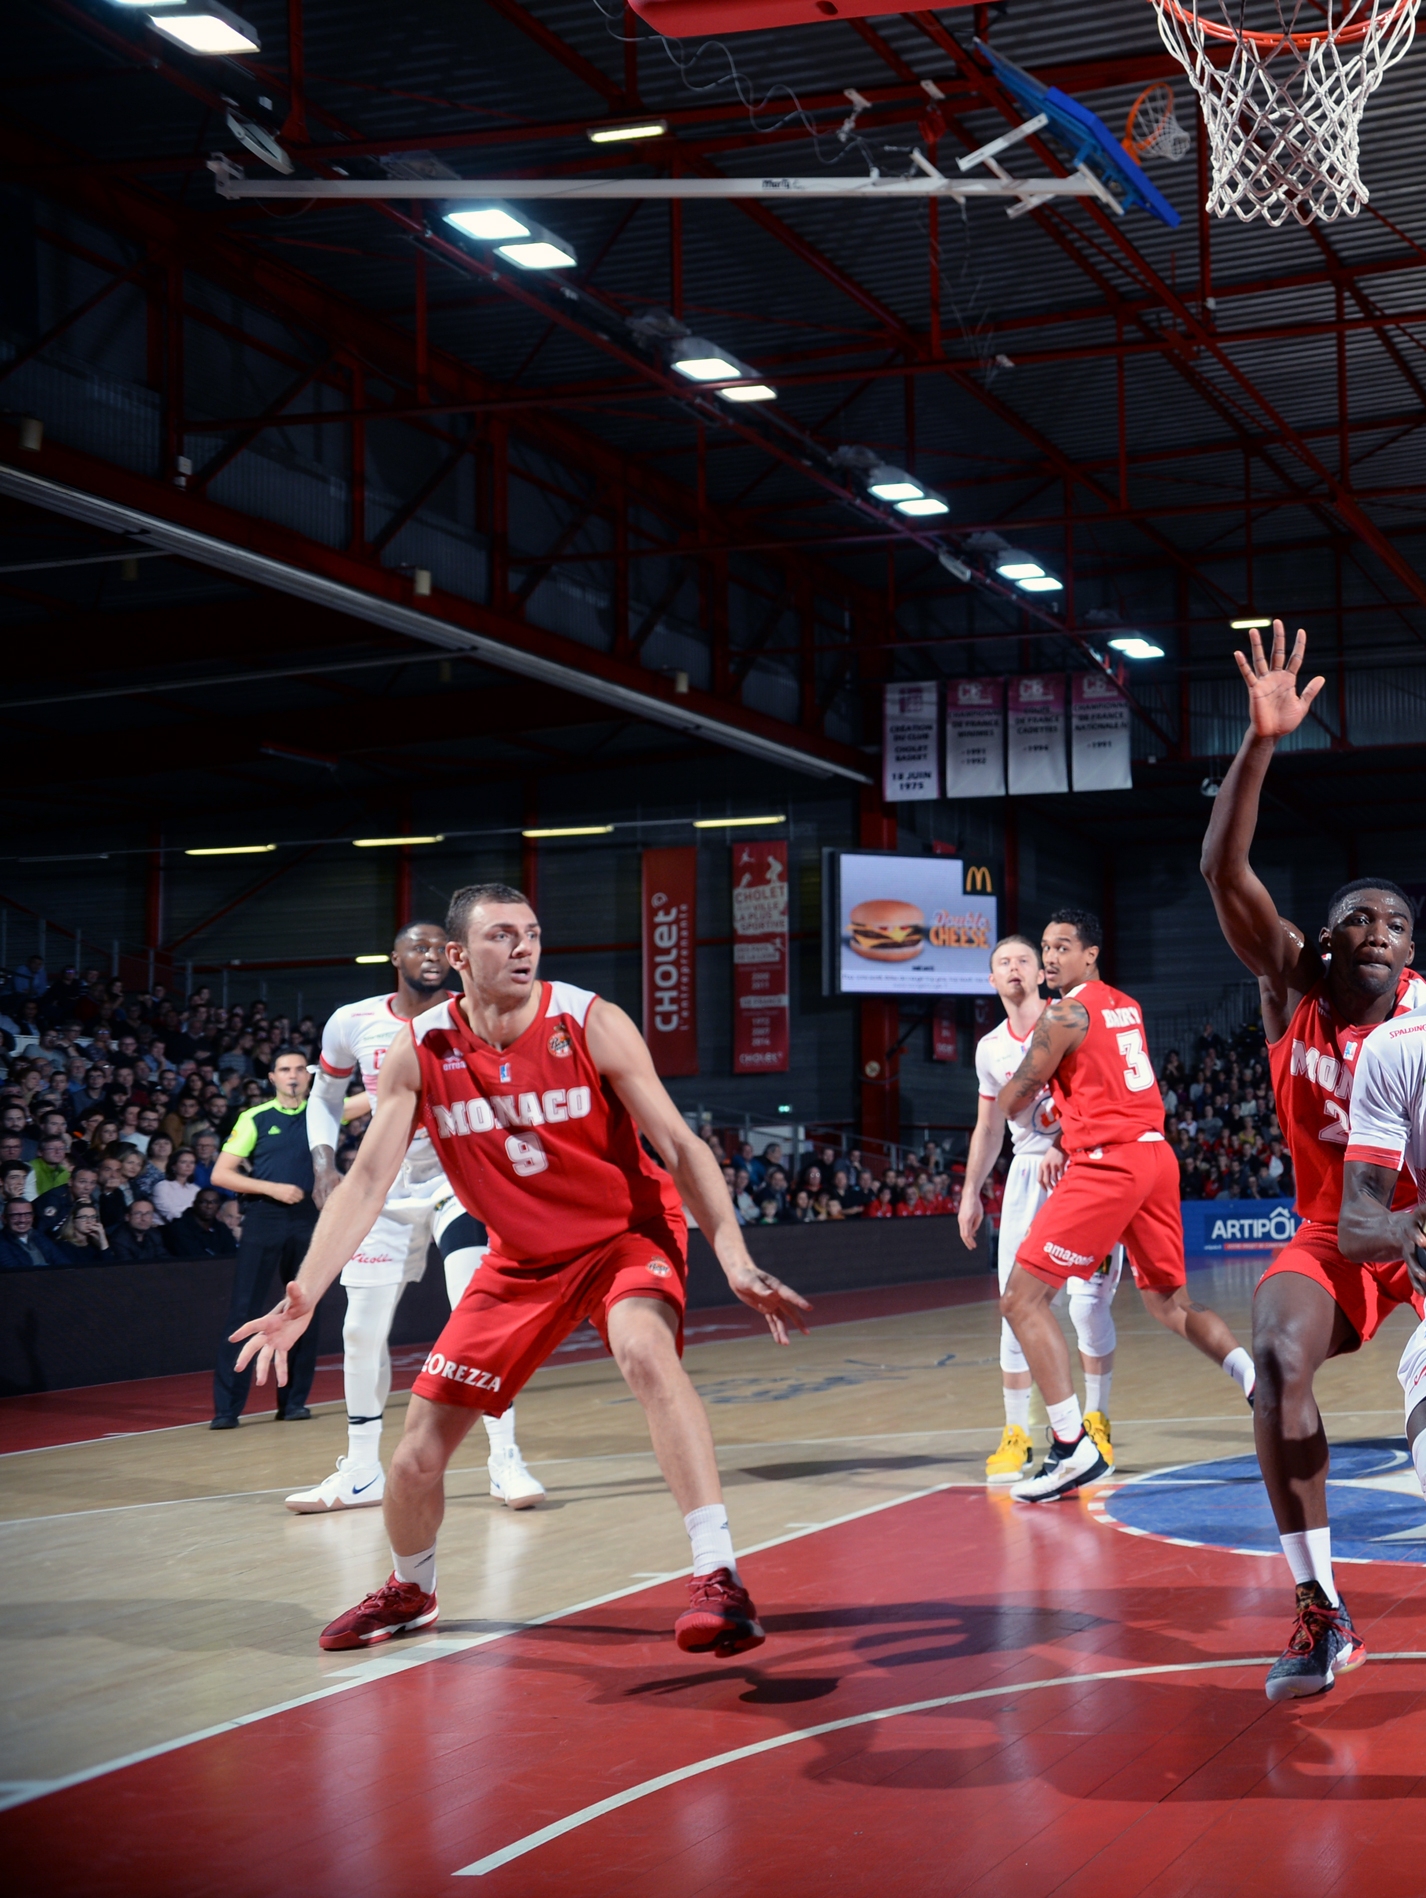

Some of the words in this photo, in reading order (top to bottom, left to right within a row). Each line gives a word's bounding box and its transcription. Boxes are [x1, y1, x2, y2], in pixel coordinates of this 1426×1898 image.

[900, 782, 924, 790] 1975
[907, 771, 931, 779] JUIN
[736, 885, 785, 904] CHOLET
[742, 920, 785, 931] SPORTIVE
[929, 927, 990, 949] CHEESE
[1116, 1028, 1155, 1092] 3
[1290, 1038, 1354, 1100] MON
[432, 1085, 591, 1139] MONACO
[504, 1131, 549, 1177] 9
[1211, 1206, 1297, 1240] ARTIPÔL
[427, 1353, 501, 1393] OREZZA
